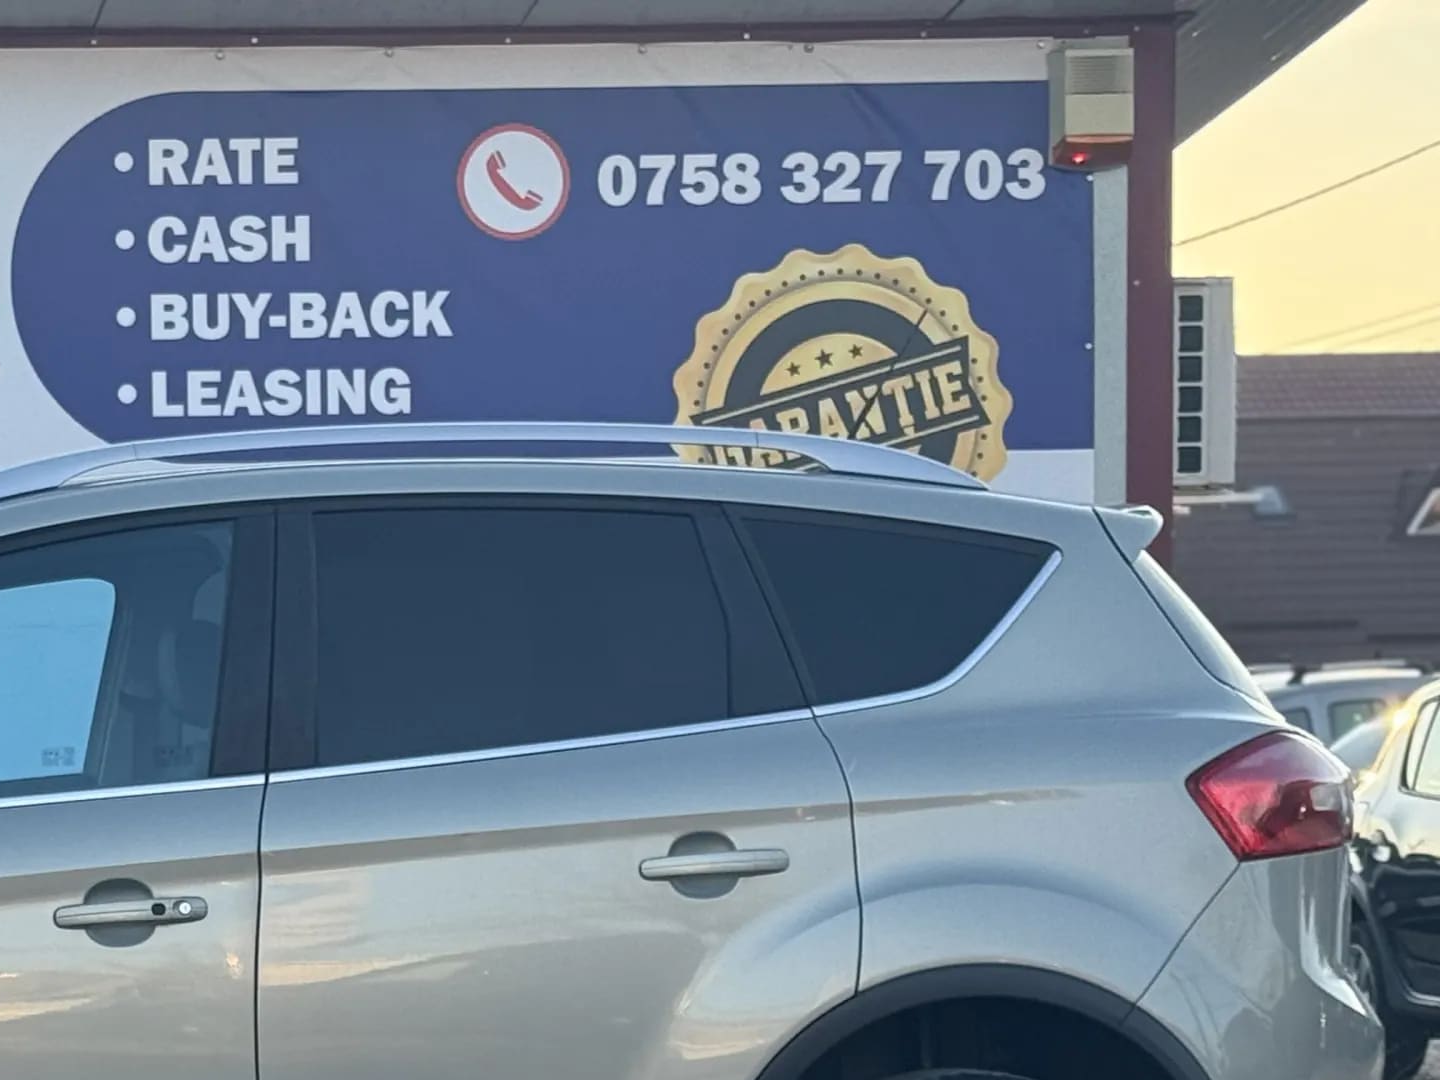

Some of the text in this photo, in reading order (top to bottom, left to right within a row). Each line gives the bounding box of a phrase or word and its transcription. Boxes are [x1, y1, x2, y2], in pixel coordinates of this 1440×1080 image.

[147, 137, 299, 186] RATE
[597, 147, 1047, 207] 0758 327 703
[147, 215, 311, 264] CASH
[150, 290, 454, 341] BUY-BACK
[151, 367, 412, 418] LEASING
